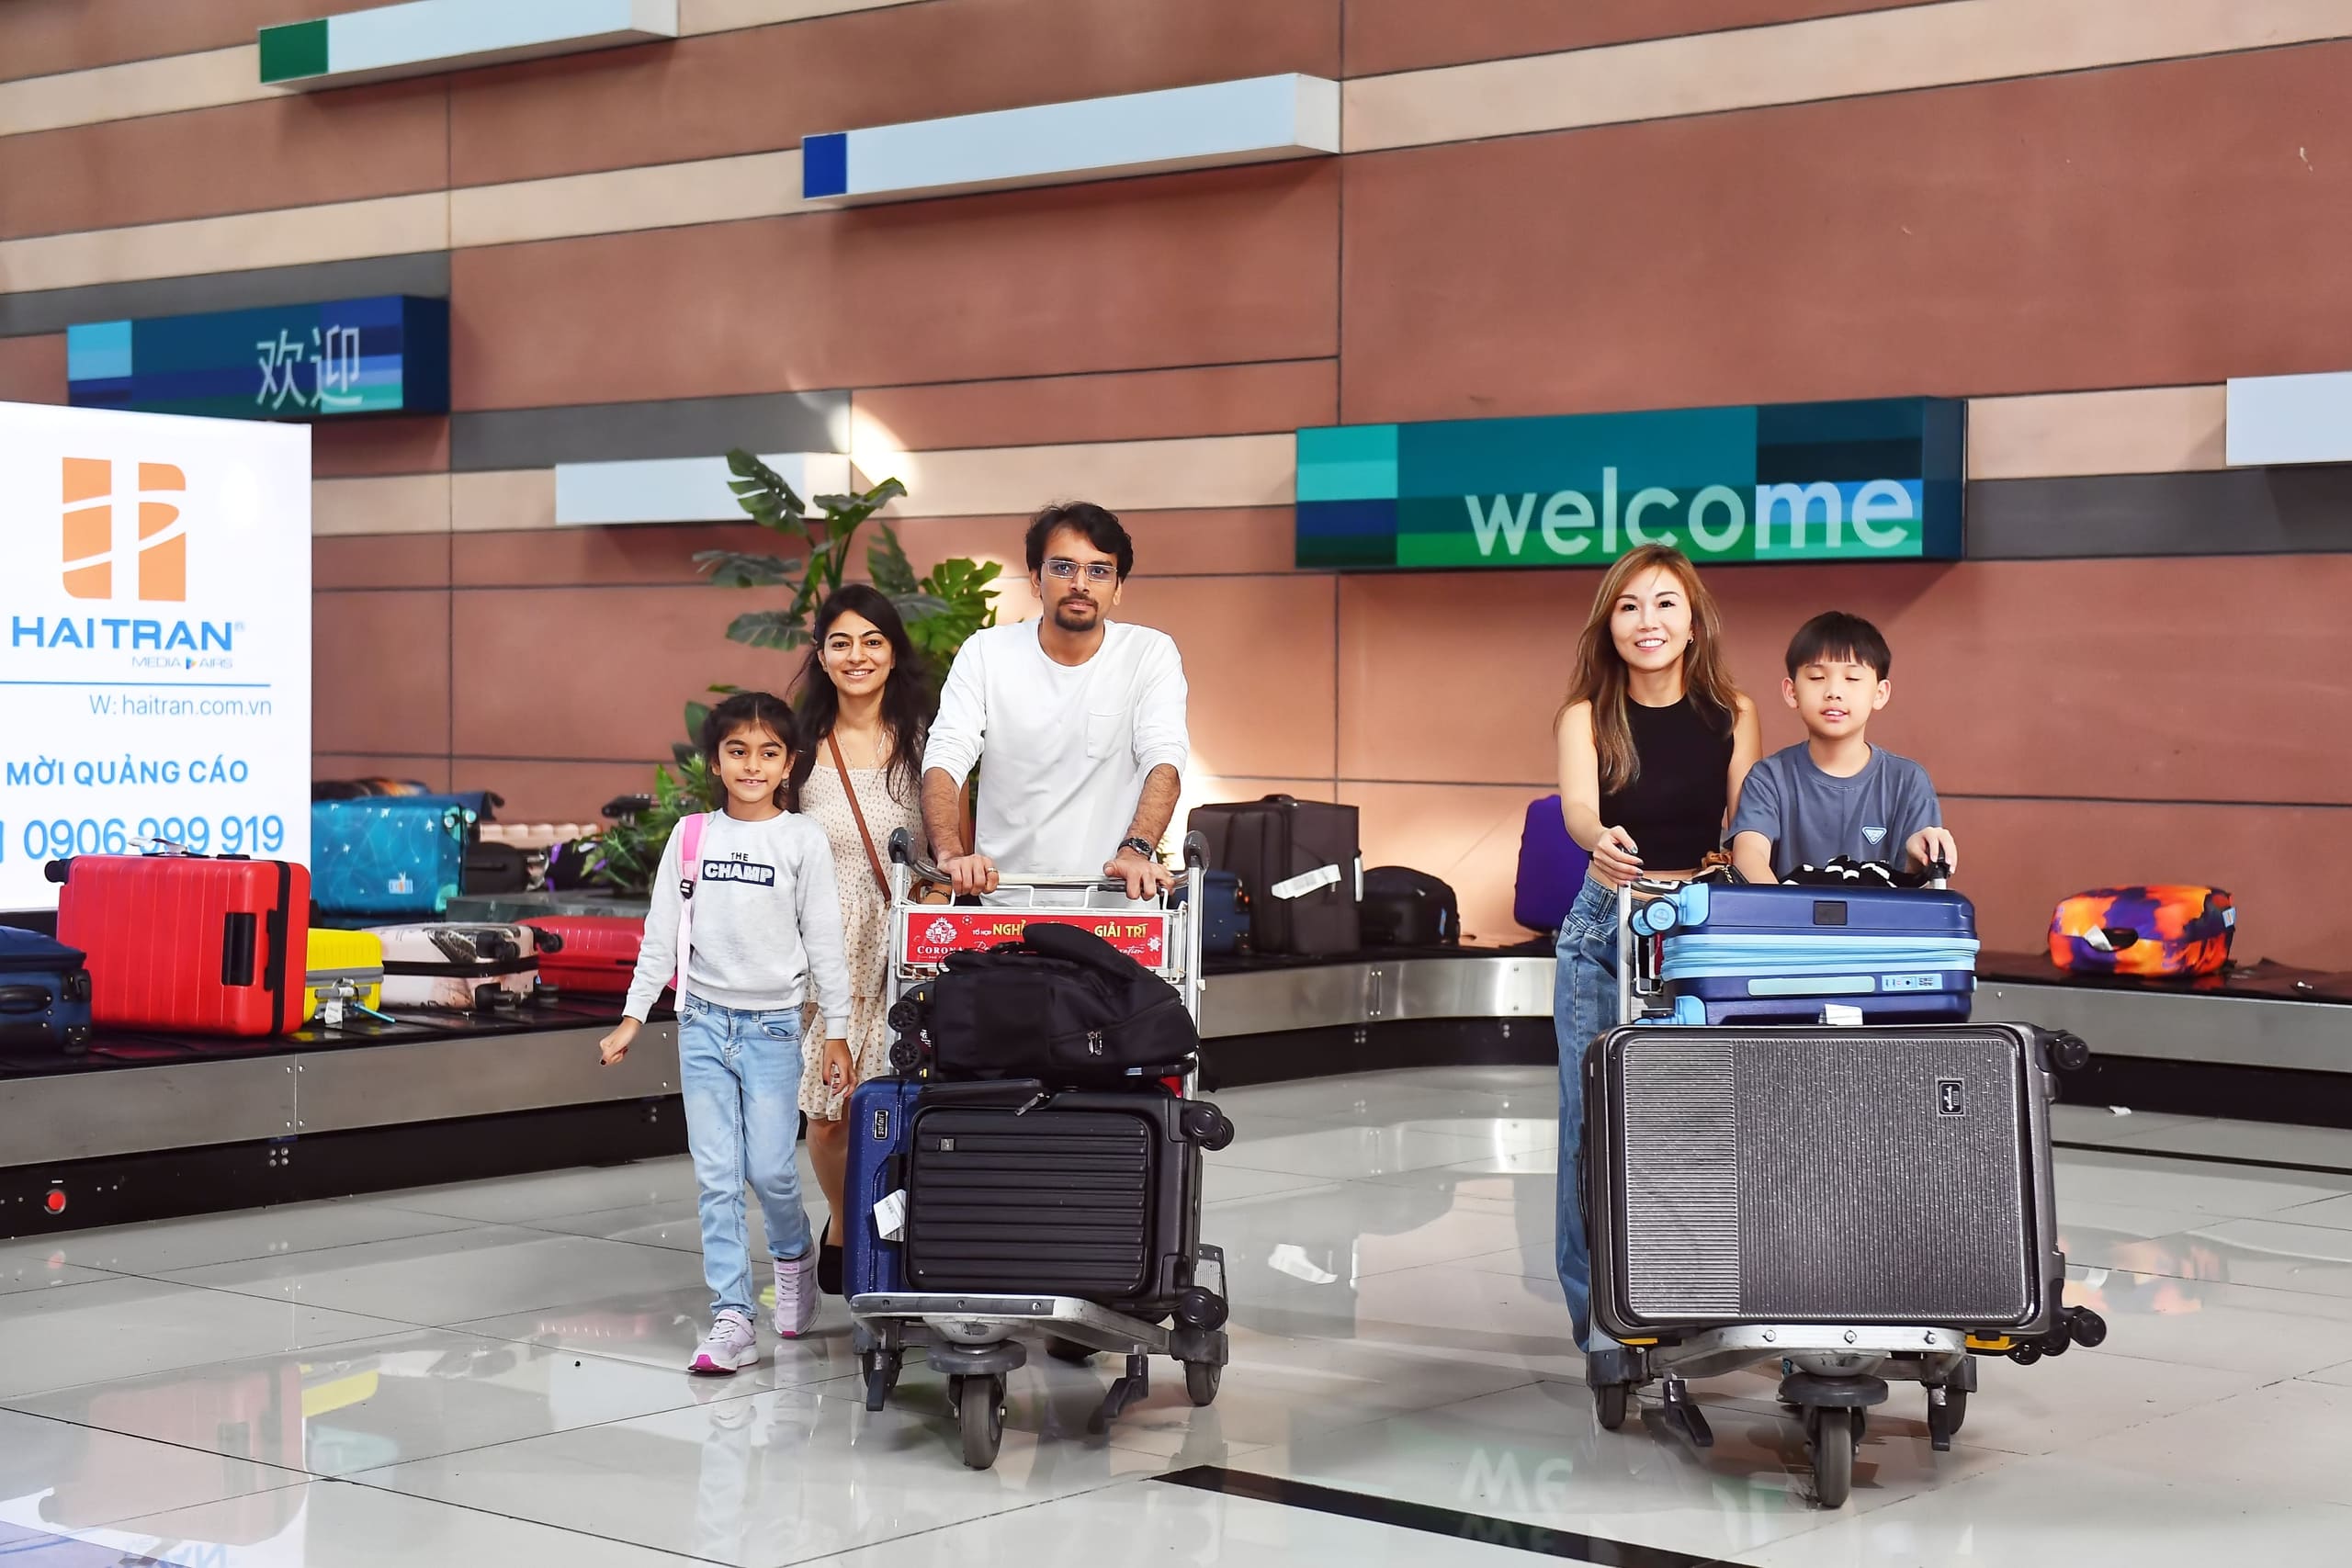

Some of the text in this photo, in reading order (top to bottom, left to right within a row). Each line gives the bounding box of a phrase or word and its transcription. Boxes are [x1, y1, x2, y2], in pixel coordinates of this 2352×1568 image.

[256, 324, 363, 411] 欢迎
[1465, 467, 1914, 557] welcome
[131, 656, 232, 669] MEDIA AIRS
[89, 694, 272, 716] W: haitran.com.vn
[6, 753, 249, 786] MỜI QUẢNG CÁO
[24, 818, 127, 859] 0906
[220, 815, 285, 854] 919
[730, 852, 750, 862] THE
[704, 863, 774, 883] CHAMP
[1094, 920, 1121, 938] GIẢI
[1125, 922, 1148, 938] TRÍ
